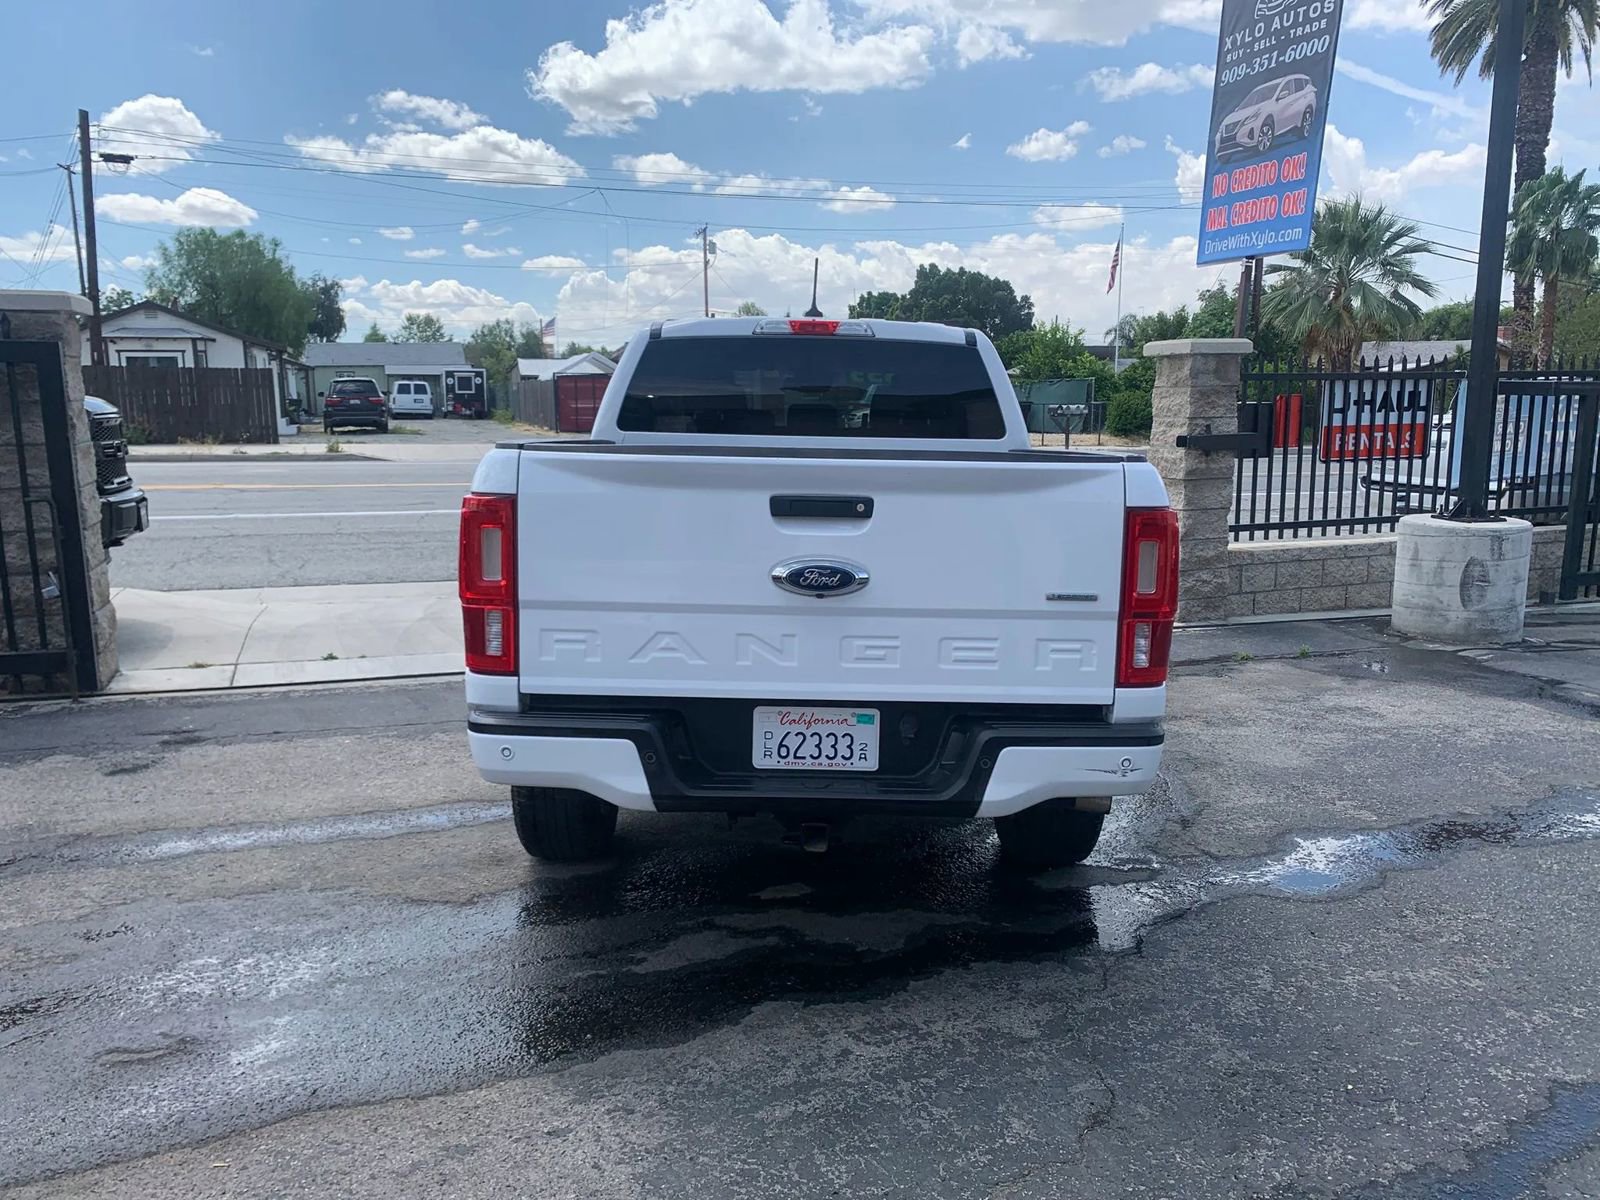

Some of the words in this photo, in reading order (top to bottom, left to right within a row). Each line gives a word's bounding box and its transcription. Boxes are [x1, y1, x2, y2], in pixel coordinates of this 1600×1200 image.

[1224, 23, 1265, 51] XYLO
[1271, 0, 1335, 31] AUTOS
[1226, 48, 1245, 62] BUY
[1254, 38, 1277, 52] SELL
[1289, 19, 1328, 39] TRADE
[1220, 35, 1330, 86] 909-351-6000
[1212, 172, 1229, 198] NO
[1231, 160, 1278, 193] CREDITO
[1281, 152, 1308, 183] OK!
[1206, 205, 1229, 232] MAL
[1231, 195, 1278, 227] CREDITO
[1281, 188, 1308, 218] OK!
[1204, 227, 1302, 255] DriveWithXylo.com
[800, 568, 841, 586] Ford
[539, 628, 1098, 671] RANGER
[780, 711, 857, 730] California
[777, 731, 854, 760] 62333
